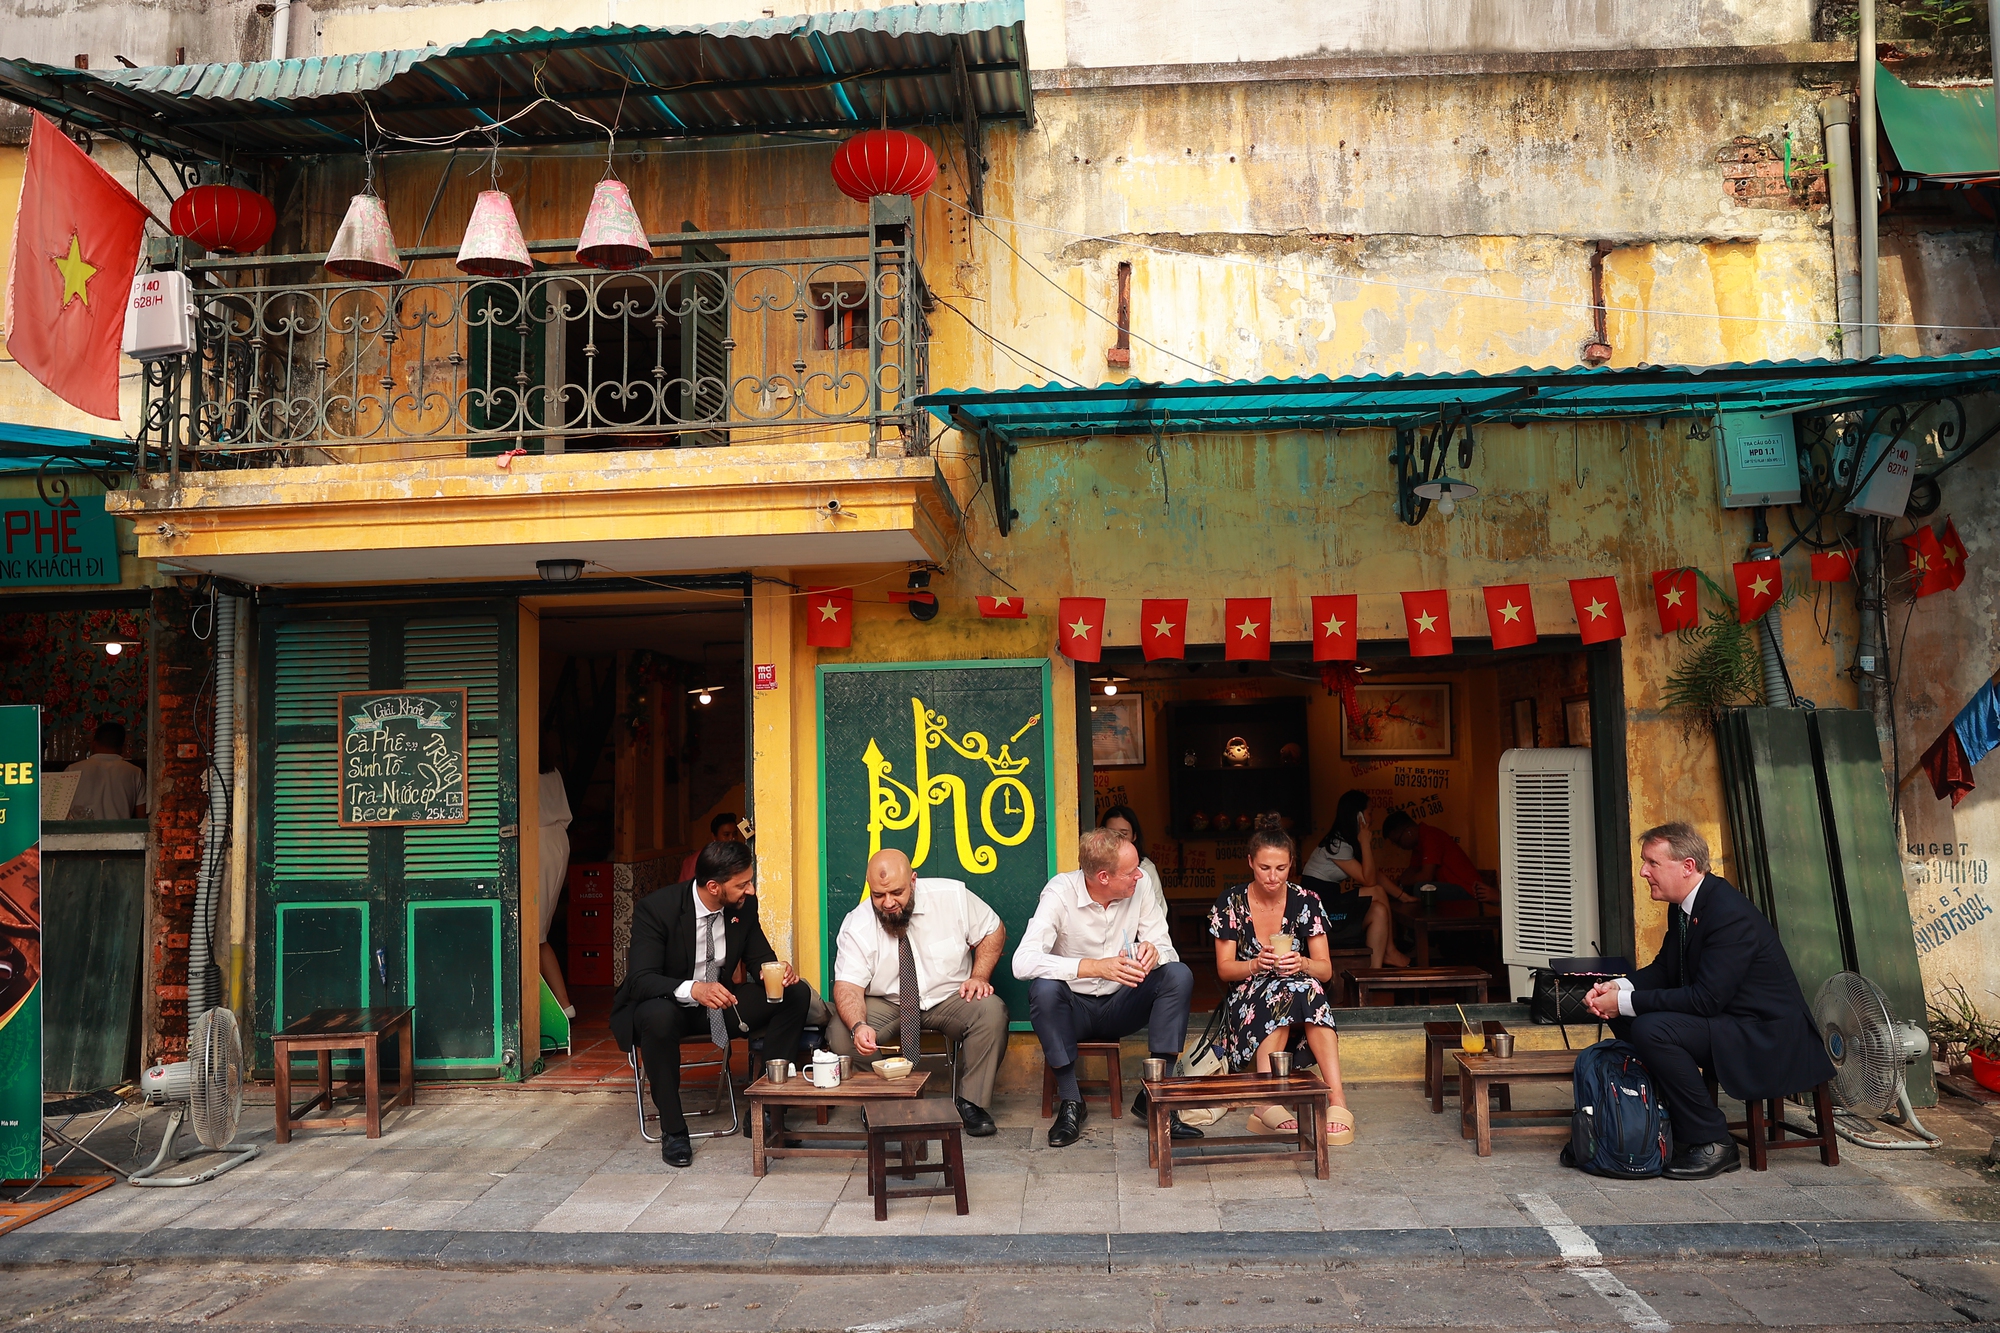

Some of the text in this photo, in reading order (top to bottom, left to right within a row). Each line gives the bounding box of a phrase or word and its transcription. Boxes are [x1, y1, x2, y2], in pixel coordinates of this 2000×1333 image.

[5, 499, 82, 554] PHÊ
[27, 553, 81, 578] KHÁCH
[86, 557, 104, 577] ĐI
[345, 733, 370, 754] Cà
[1394, 773, 1450, 789] 0912931071
[1420, 793, 1440, 804] XE
[352, 806, 400, 822] Beer
[1427, 800, 1444, 816] 388
